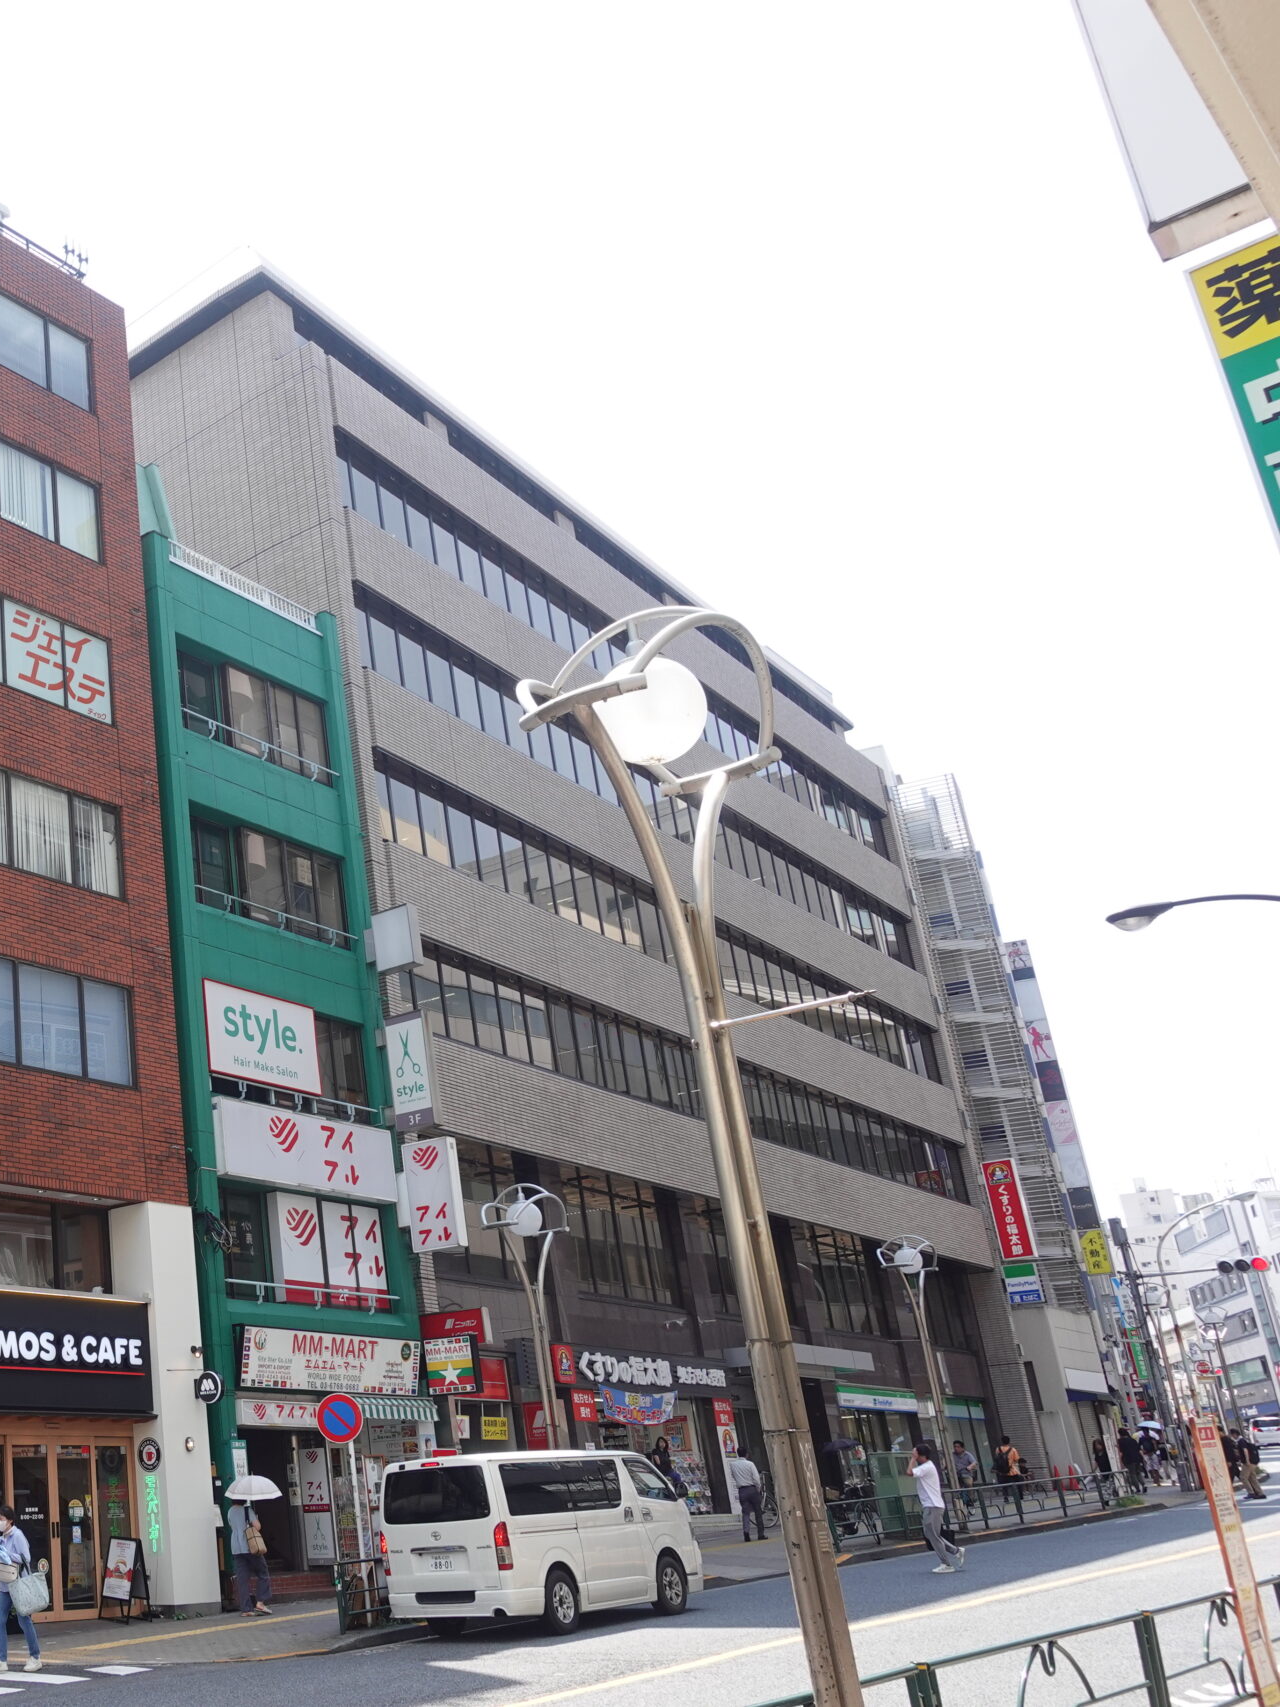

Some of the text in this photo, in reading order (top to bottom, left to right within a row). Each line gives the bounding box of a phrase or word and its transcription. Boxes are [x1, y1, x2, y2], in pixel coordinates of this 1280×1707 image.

[10, 609, 92, 662] ジェイ
[18, 651, 106, 705] エステ
[233, 1055, 299, 1080] Hair Make Salon
[408, 1114, 422, 1126] 3F
[998, 1185, 1024, 1256] くすりの福太郎
[1007, 1280, 1036, 1288] FamilyMart
[61, 1336, 78, 1363] &
[80, 1335, 143, 1366] CAFE
[292, 1333, 379, 1360] MM-MART
[425, 1345, 470, 1358] MM-MART
[579, 1351, 672, 1387] くすりの福太郎
[307, 1372, 327, 1380] WORLD
[307, 1381, 318, 1389] TEL
[574, 1393, 594, 1404] 処方せん
[580, 1406, 591, 1418] 受付
[312, 1541, 329, 1552] style
